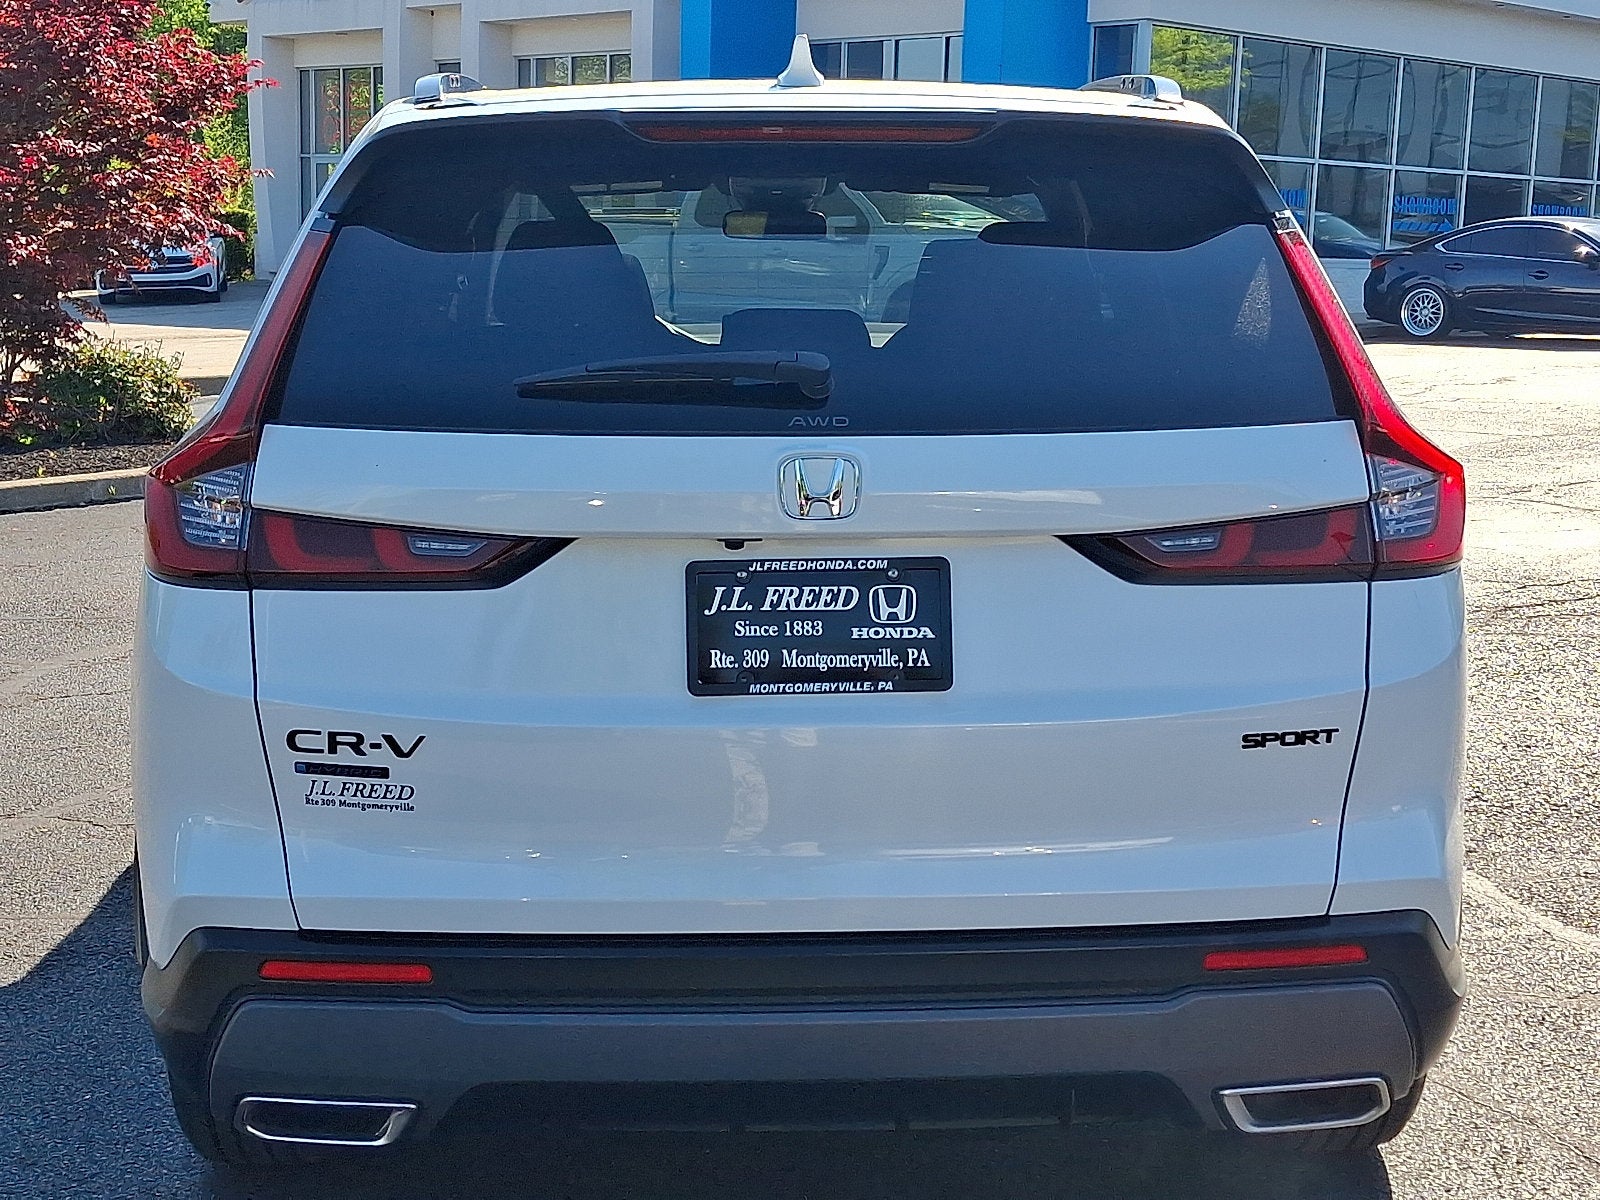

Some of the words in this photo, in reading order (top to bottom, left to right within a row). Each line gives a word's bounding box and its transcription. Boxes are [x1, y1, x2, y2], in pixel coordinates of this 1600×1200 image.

[788, 416, 849, 427] AWD
[748, 559, 888, 572] JLFREEDHONDA.COM
[704, 586, 753, 615] J.L.
[760, 586, 860, 611] FREED
[734, 620, 779, 637] Since
[784, 620, 823, 636] 1883
[851, 627, 936, 639] HONDA
[709, 649, 739, 668] Rte.
[742, 649, 770, 668] 309
[781, 648, 903, 671] Montgomeryville,
[907, 648, 931, 667] PA
[749, 681, 875, 694] MONTGOMERYVILLE,
[877, 681, 894, 691] PA
[286, 729, 427, 759] CR-V
[1241, 727, 1340, 750] SPORT
[304, 779, 337, 797] J.L.
[338, 781, 416, 801] FREED
[305, 797, 320, 806] Rte
[321, 798, 337, 807] 309
[338, 799, 416, 813] Montgomeryville
